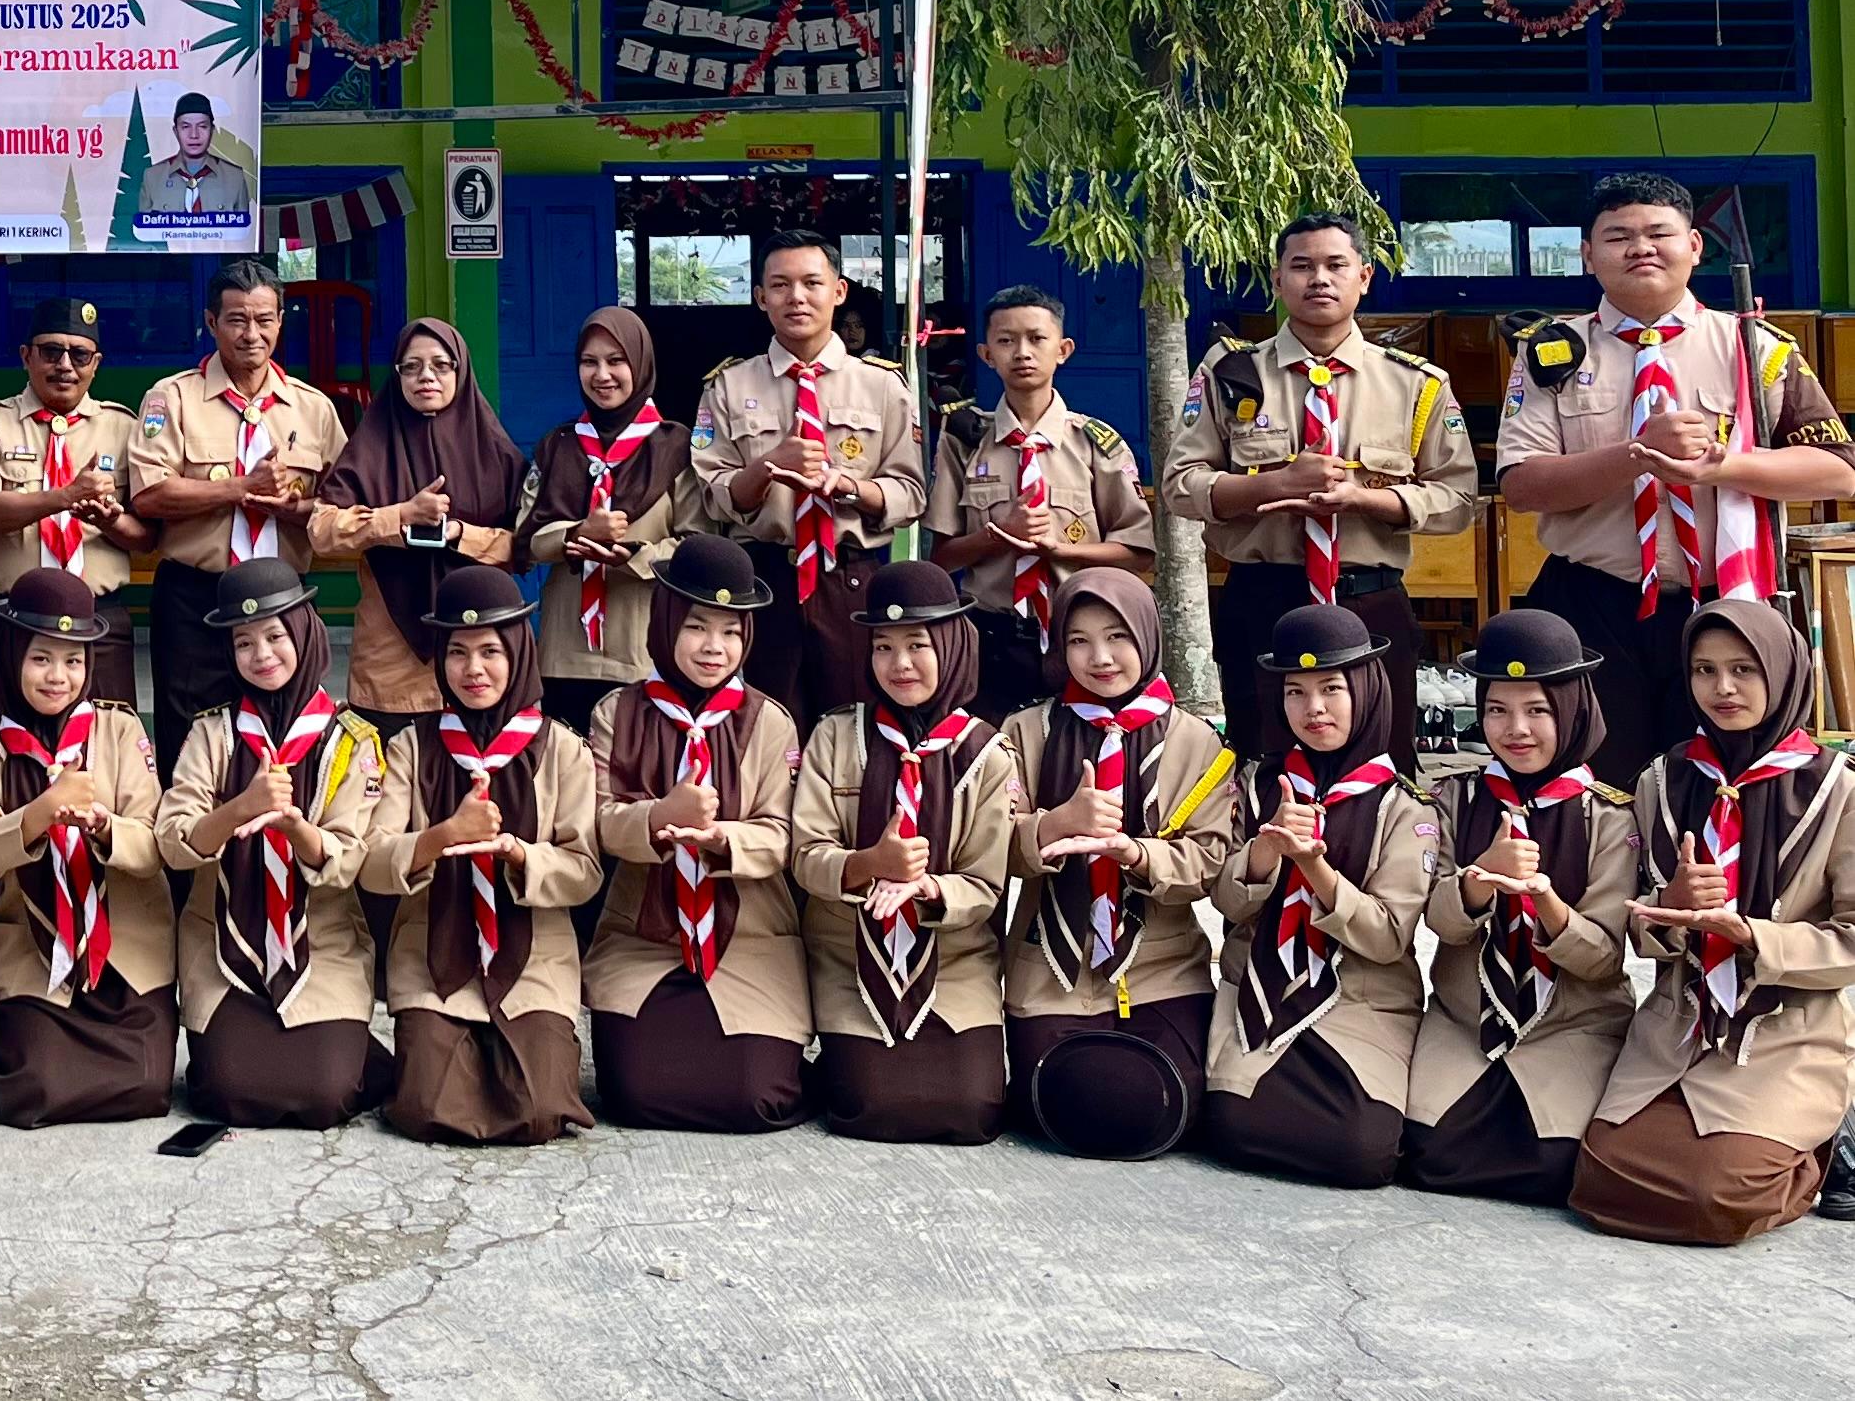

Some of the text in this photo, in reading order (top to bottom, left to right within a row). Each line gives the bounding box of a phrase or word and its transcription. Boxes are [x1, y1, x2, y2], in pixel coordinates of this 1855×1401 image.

[71, 3, 130, 29] 2025
[76, 123, 103, 159] yg
[449, 155, 492, 163] PERHATIAN
[142, 214, 245, 227] Dafri hayani, M.Pd
[12, 226, 17, 238] 1
[18, 226, 63, 238] KERINCI
